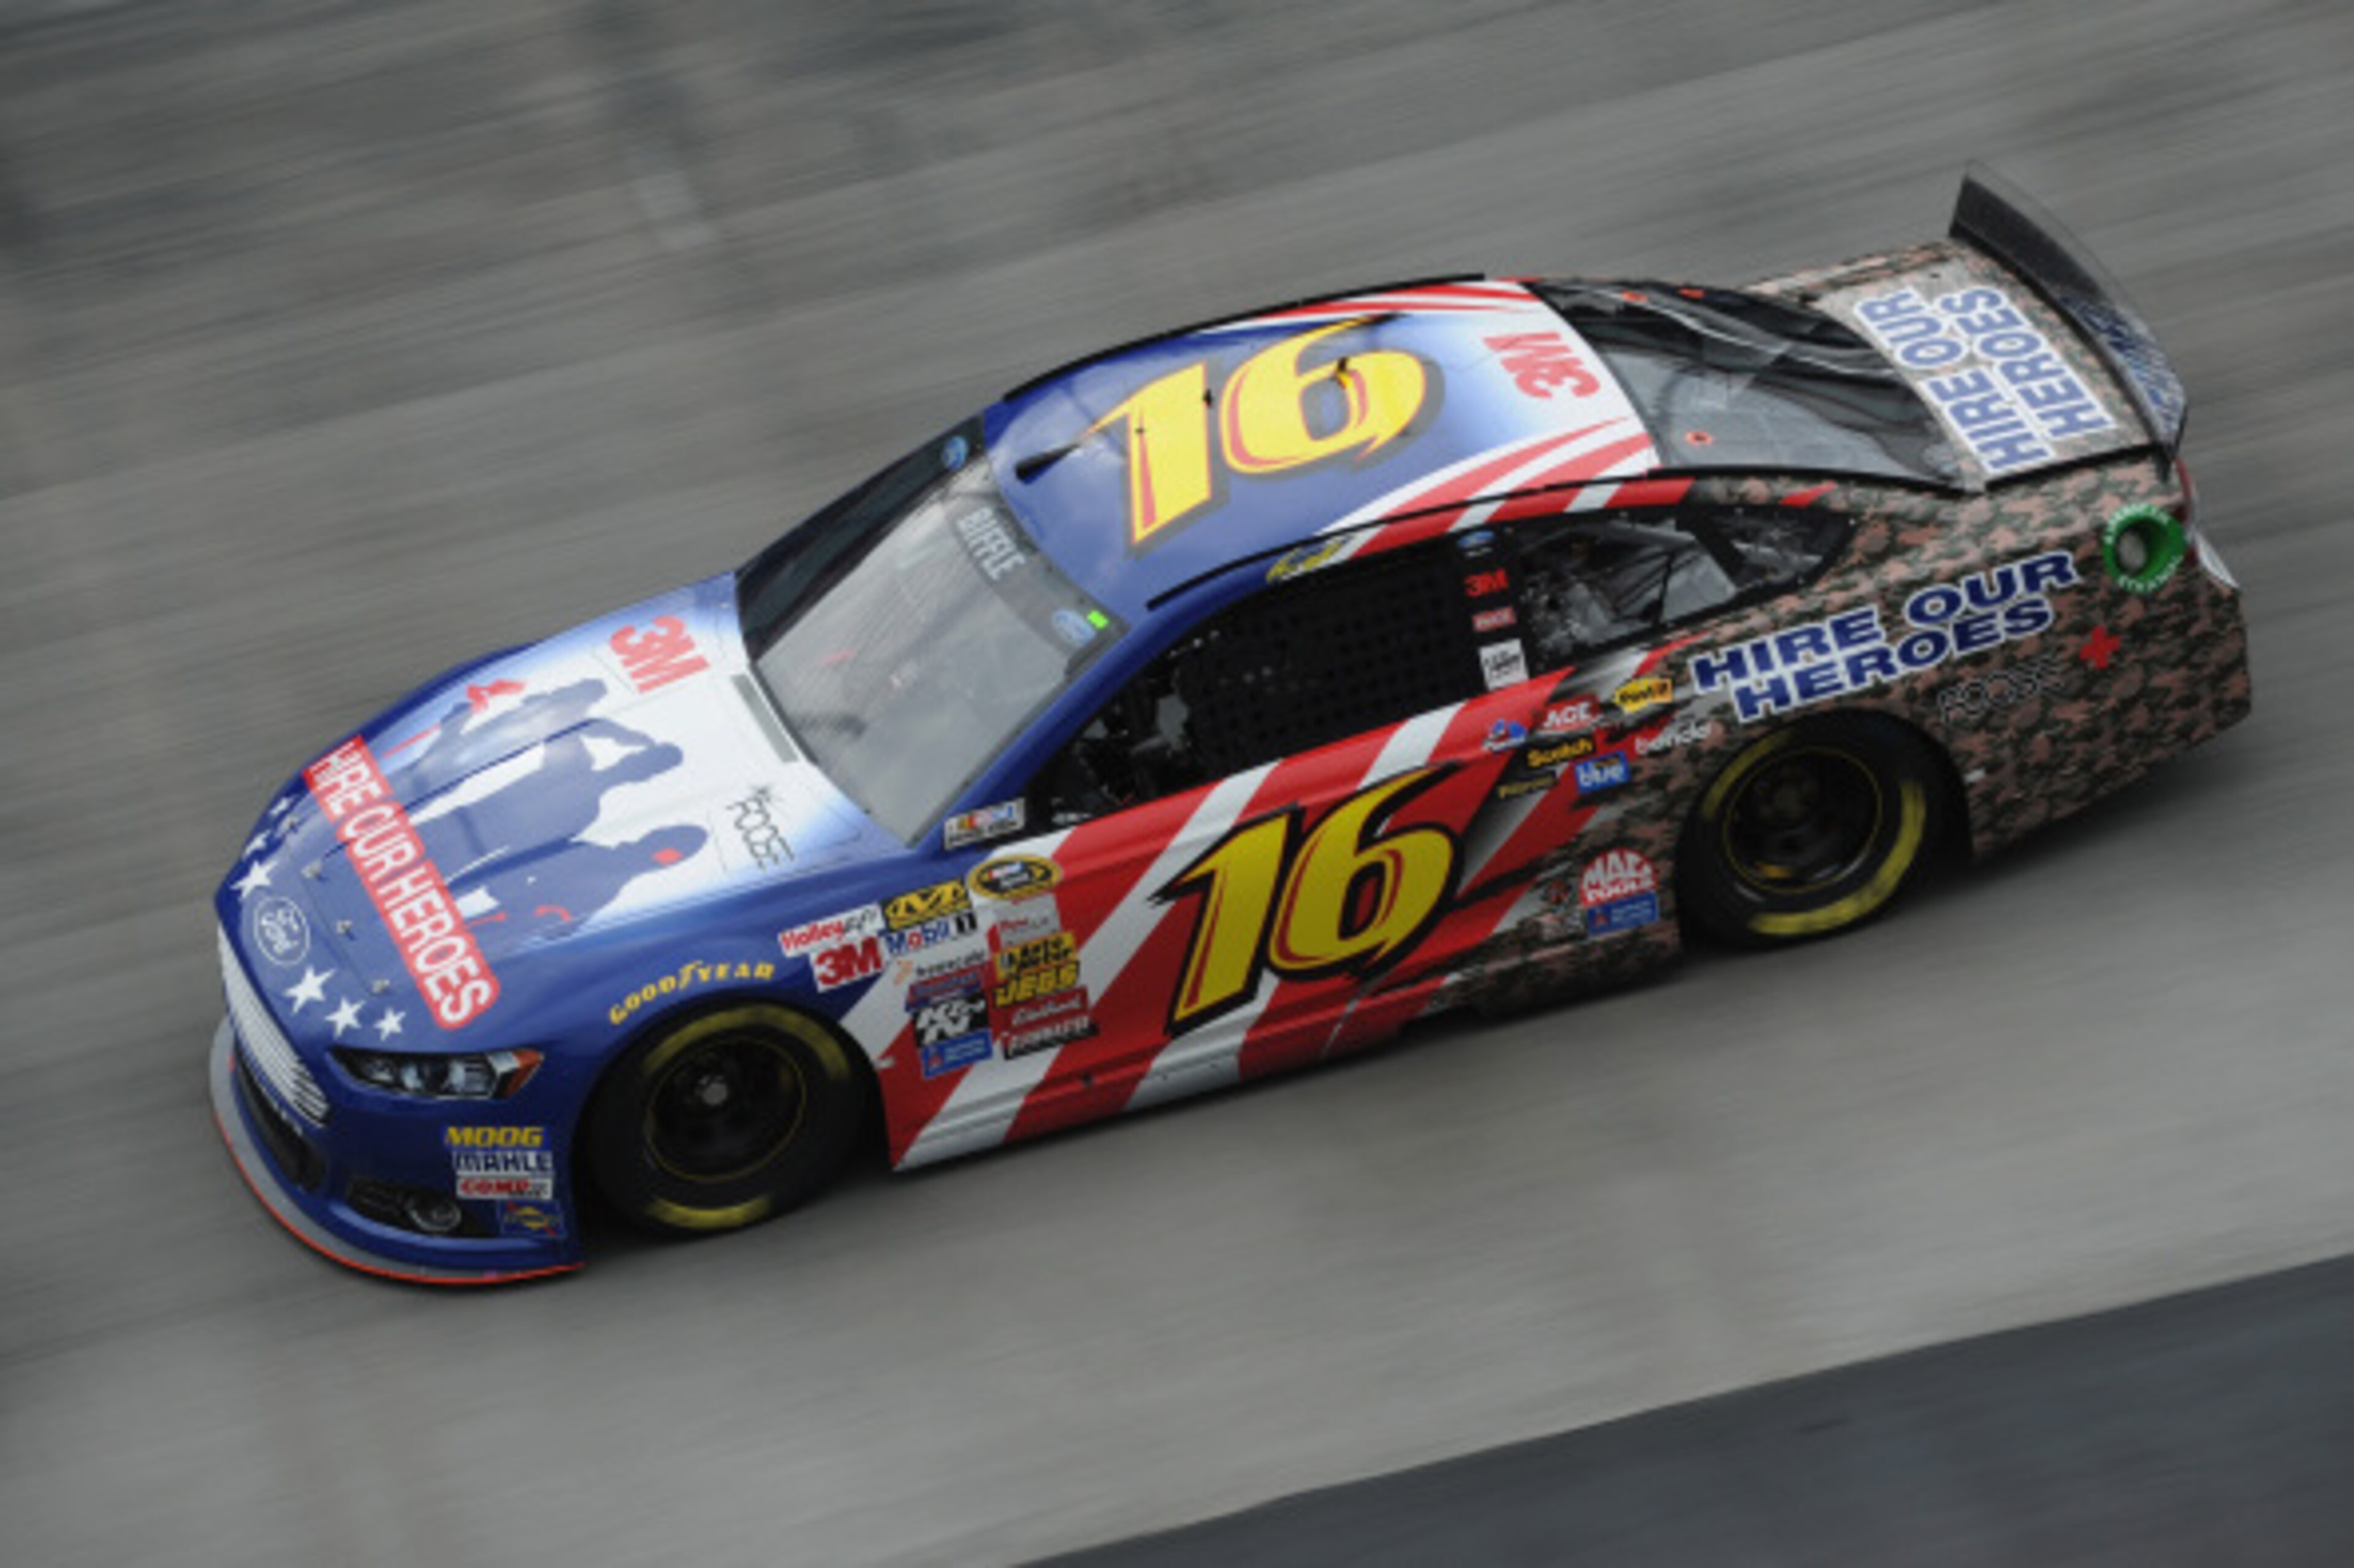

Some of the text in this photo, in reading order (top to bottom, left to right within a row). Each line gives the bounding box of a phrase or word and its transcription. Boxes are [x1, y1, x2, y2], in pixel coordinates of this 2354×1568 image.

[1484, 331, 1600, 400] 3M
[1856, 288, 2054, 472] HIRE OUR
[1938, 287, 2112, 438] HEROES
[1082, 313, 1427, 547] 16
[1464, 568, 1509, 597] 3M
[1693, 554, 2077, 690] HIRE OUR
[609, 614, 710, 695] 3M
[1733, 598, 2052, 720] HEROES
[313, 739, 492, 1024] HIRE OUR HEROES
[1156, 763, 1461, 1033] 16
[814, 935, 883, 986] 3M
[444, 1126, 545, 1148] MOOG
